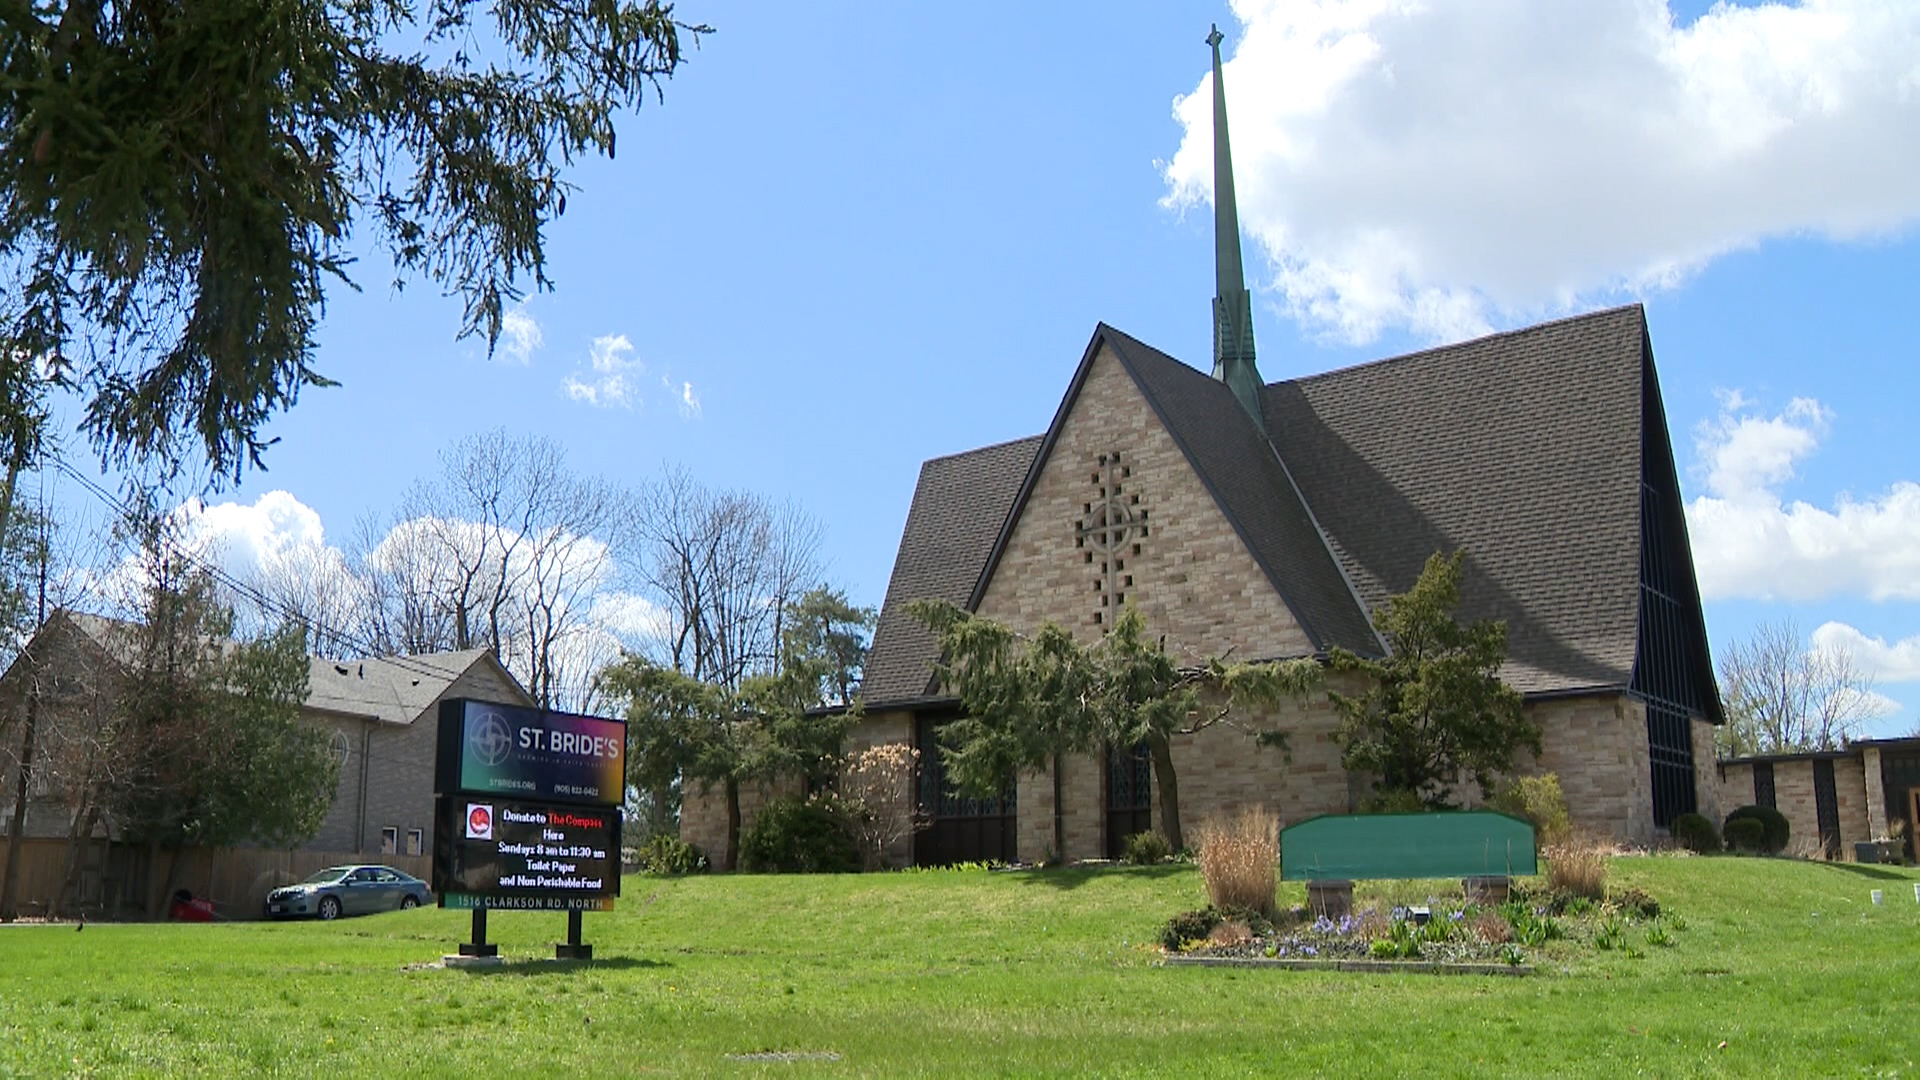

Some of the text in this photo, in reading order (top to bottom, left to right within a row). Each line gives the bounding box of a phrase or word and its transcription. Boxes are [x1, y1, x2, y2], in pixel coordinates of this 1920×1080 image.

[519, 727, 619, 759] ST. BRIDE'S
[503, 809, 603, 829] Donate to The Compass
[543, 829, 565, 841] Here
[498, 841, 606, 859] Sundays 8 am to 11:30 am
[526, 859, 576, 874] Toilet Paper
[499, 875, 602, 889] and Non Perishable Food
[458, 897, 604, 910] 1516 CLARKSON RD. NORTH
